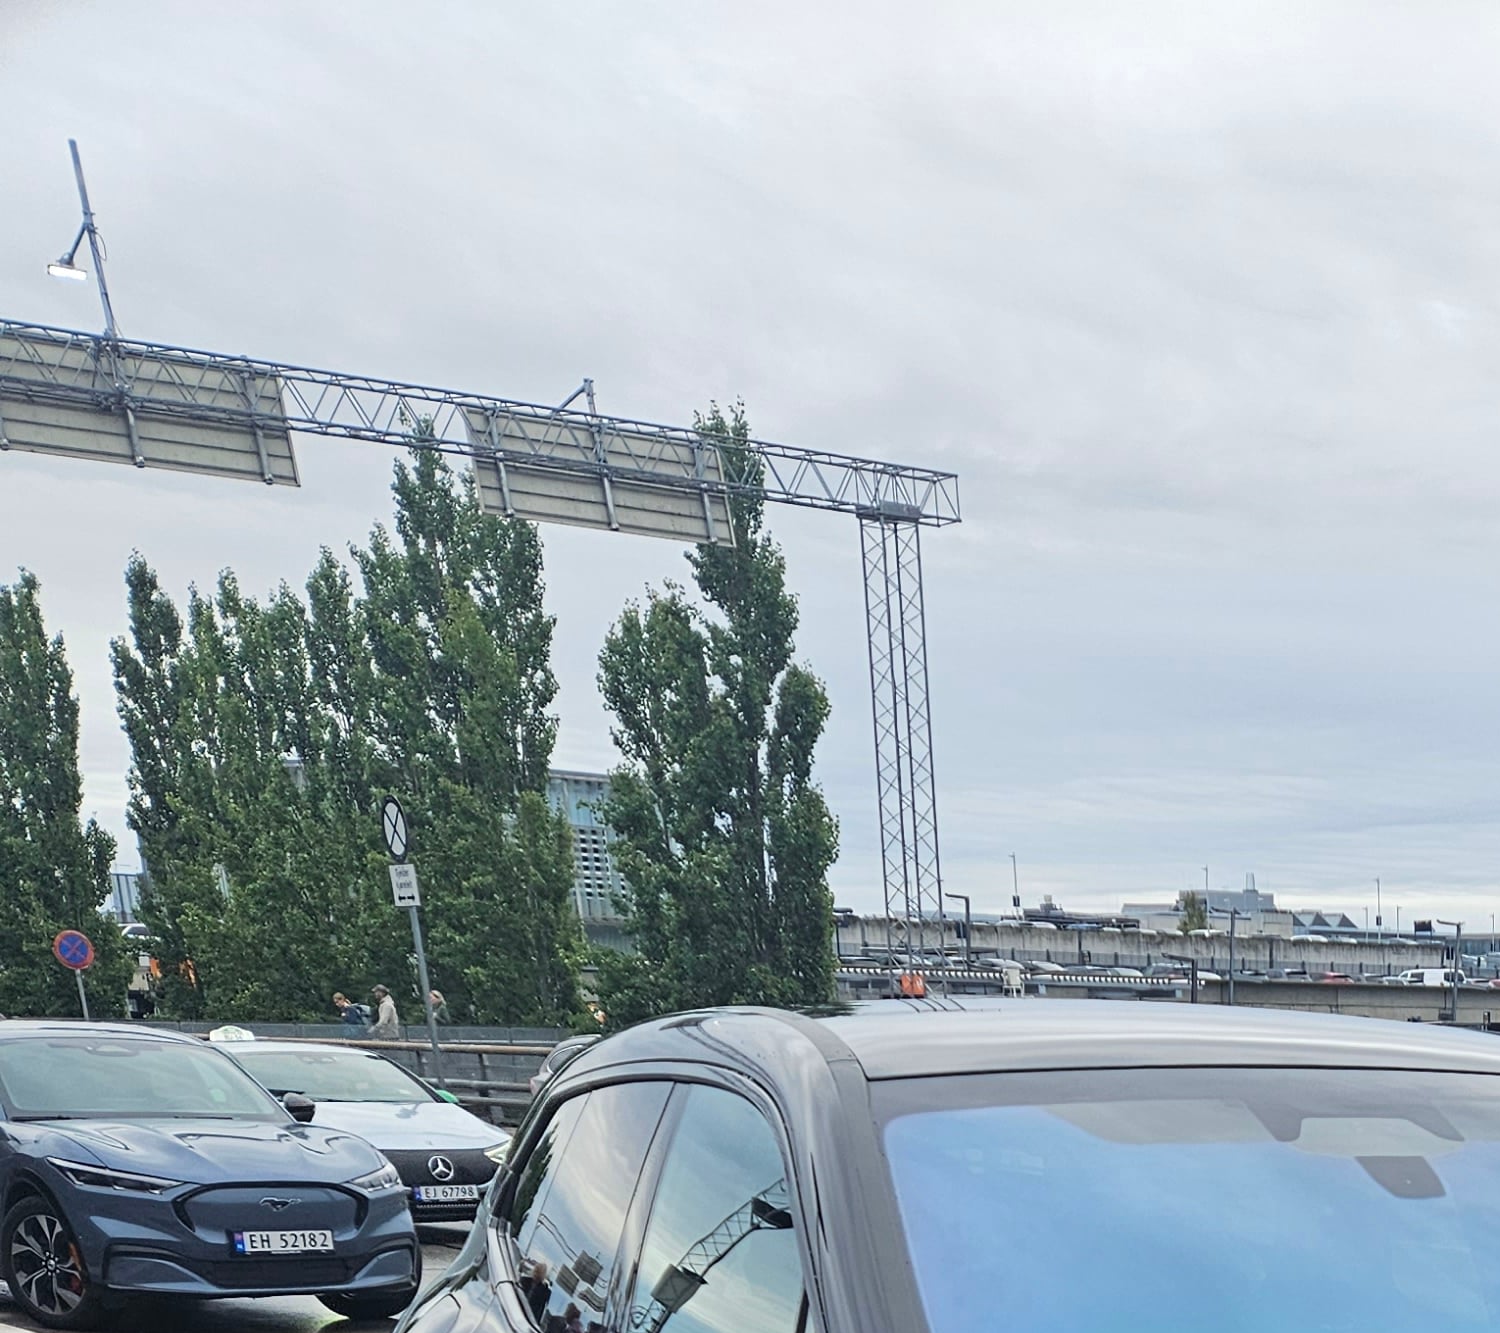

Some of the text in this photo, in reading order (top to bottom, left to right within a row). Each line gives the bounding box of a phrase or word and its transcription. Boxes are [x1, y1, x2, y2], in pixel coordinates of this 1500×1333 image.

[425, 1186, 474, 1198] EJ 67798
[249, 1232, 329, 1249] EH 52182
